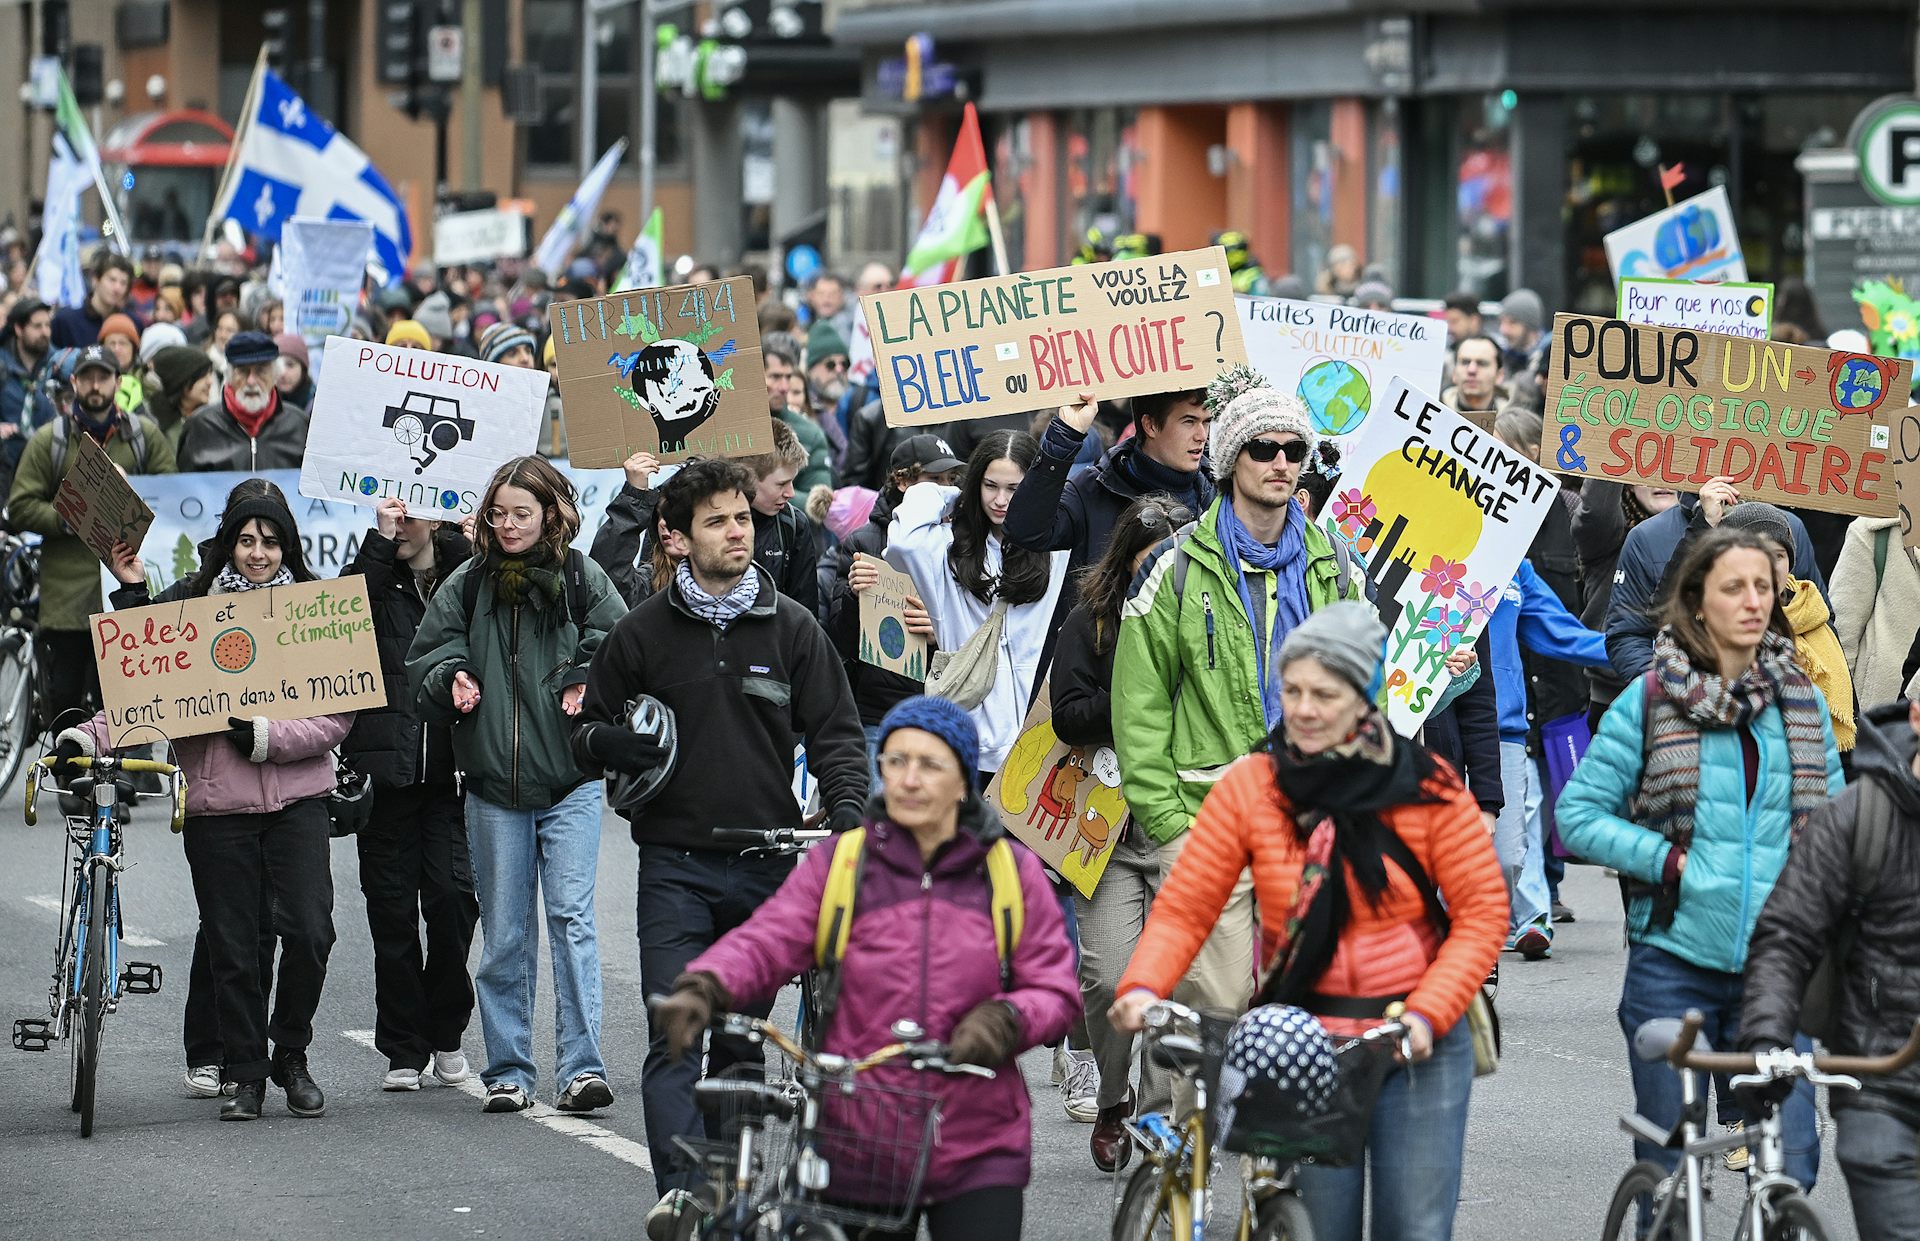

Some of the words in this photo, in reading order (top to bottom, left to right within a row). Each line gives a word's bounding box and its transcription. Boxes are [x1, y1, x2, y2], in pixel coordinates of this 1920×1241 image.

[1091, 267, 1147, 289] VOUS
[1159, 263, 1189, 282] LA
[1106, 280, 1190, 307] VOULEZ
[678, 282, 736, 328] 404
[875, 292, 933, 344] LA
[939, 274, 1078, 333] PLANÈTE
[1250, 301, 1314, 326] Faites
[1329, 308, 1386, 335] Partie
[1388, 318, 1408, 338] de
[1409, 321, 1428, 341] la
[1629, 287, 1668, 311] Pour
[1676, 296, 1702, 319] que
[1711, 297, 1742, 316] nos
[891, 345, 990, 413] BLEUE
[1204, 310, 1225, 364] ?
[1290, 328, 1383, 360] SOLUTION
[1563, 318, 1699, 388] POUR
[1722, 339, 1793, 393] UN
[358, 348, 500, 393] POLLUTION
[1555, 372, 1838, 443] ÉCOLOGIQUE
[1393, 388, 1442, 435] LE
[1450, 425, 1554, 504] CLIMAT
[1556, 423, 1587, 473] &
[1600, 428, 1887, 501] SOLIDAIRE
[1401, 435, 1519, 524] CHANGE
[56, 480, 88, 532] PAS
[215, 602, 237, 623] et
[284, 590, 363, 622] Justice
[97, 617, 198, 660] Pales
[276, 617, 373, 647] climatique
[120, 650, 192, 678] tine
[110, 694, 165, 727] vont
[174, 688, 232, 719] main
[240, 687, 275, 708] dans
[281, 679, 299, 700] la
[307, 668, 376, 700] main
[1387, 668, 1433, 713] PAS
